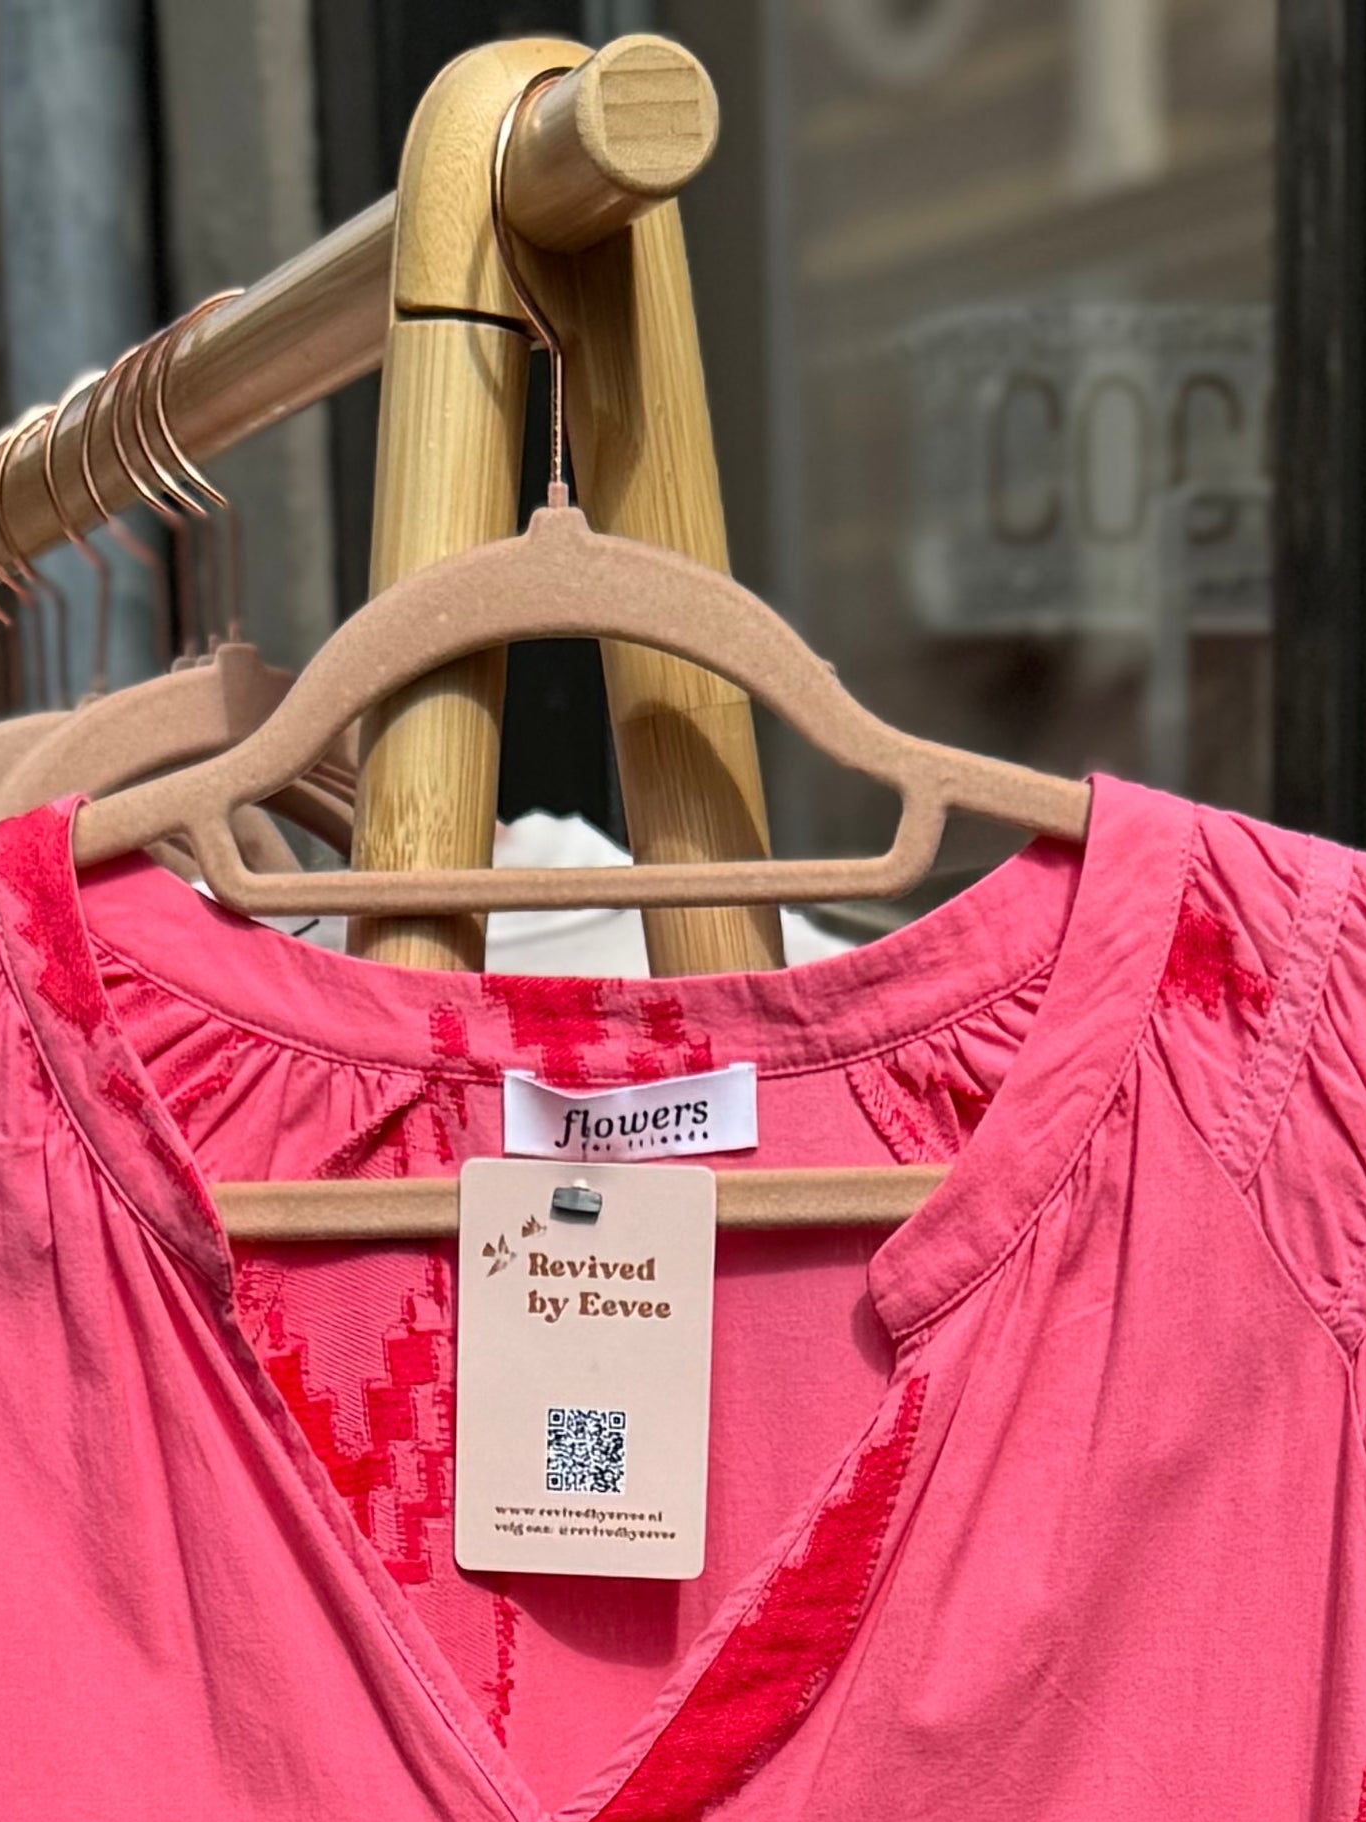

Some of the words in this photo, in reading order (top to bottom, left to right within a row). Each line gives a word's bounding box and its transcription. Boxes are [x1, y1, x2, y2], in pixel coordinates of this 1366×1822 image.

[554, 1099, 709, 1149] flowers
[528, 1252, 656, 1281] Revived
[528, 1289, 570, 1324] by
[578, 1291, 672, 1319] Eevee
